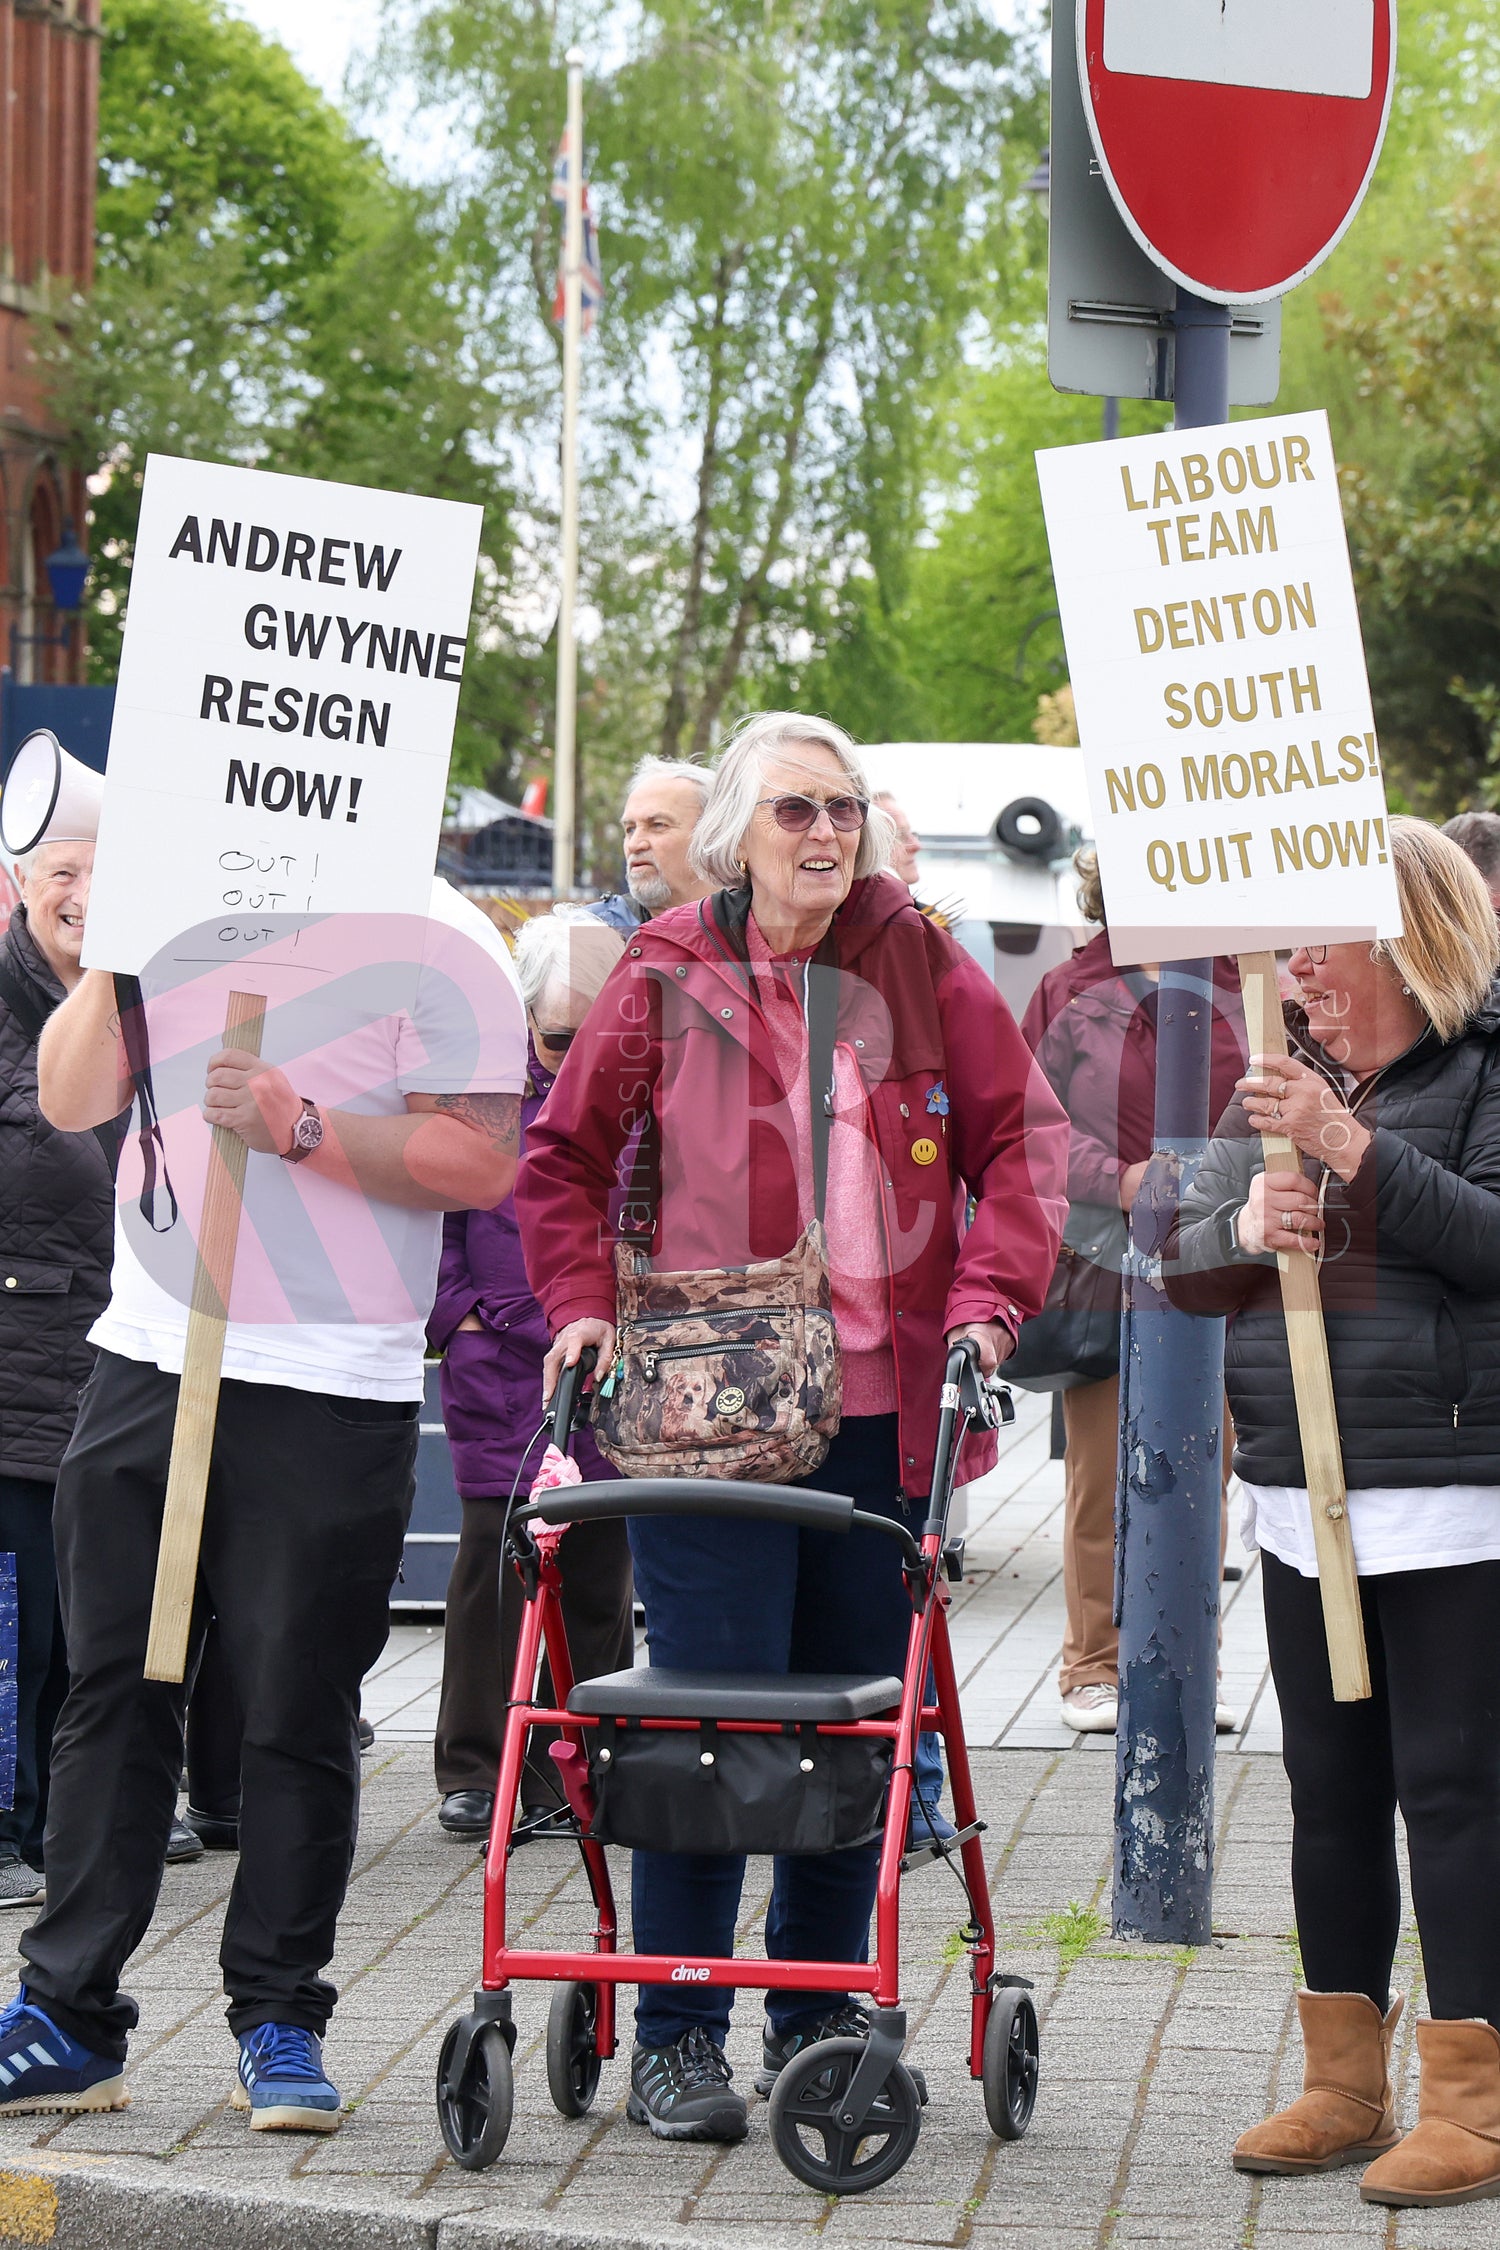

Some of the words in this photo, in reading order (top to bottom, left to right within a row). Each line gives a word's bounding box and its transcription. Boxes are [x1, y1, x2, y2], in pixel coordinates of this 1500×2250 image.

[1120, 436, 1315, 511] LABOUR
[168, 515, 402, 592] ANDREW
[1147, 506, 1278, 566] TEAM
[245, 604, 467, 682] GWYNNE
[1134, 582, 1316, 653] DENTON
[200, 674, 391, 747] RESIGN
[1164, 665, 1321, 729] SOUTH
[225, 759, 362, 823] NOW!
[1105, 763, 1166, 813] NO
[1181, 732, 1379, 802] MORALS!
[1147, 832, 1252, 892] QUIT
[1271, 818, 1388, 873] NOW!
[671, 1964, 711, 1981] drive
